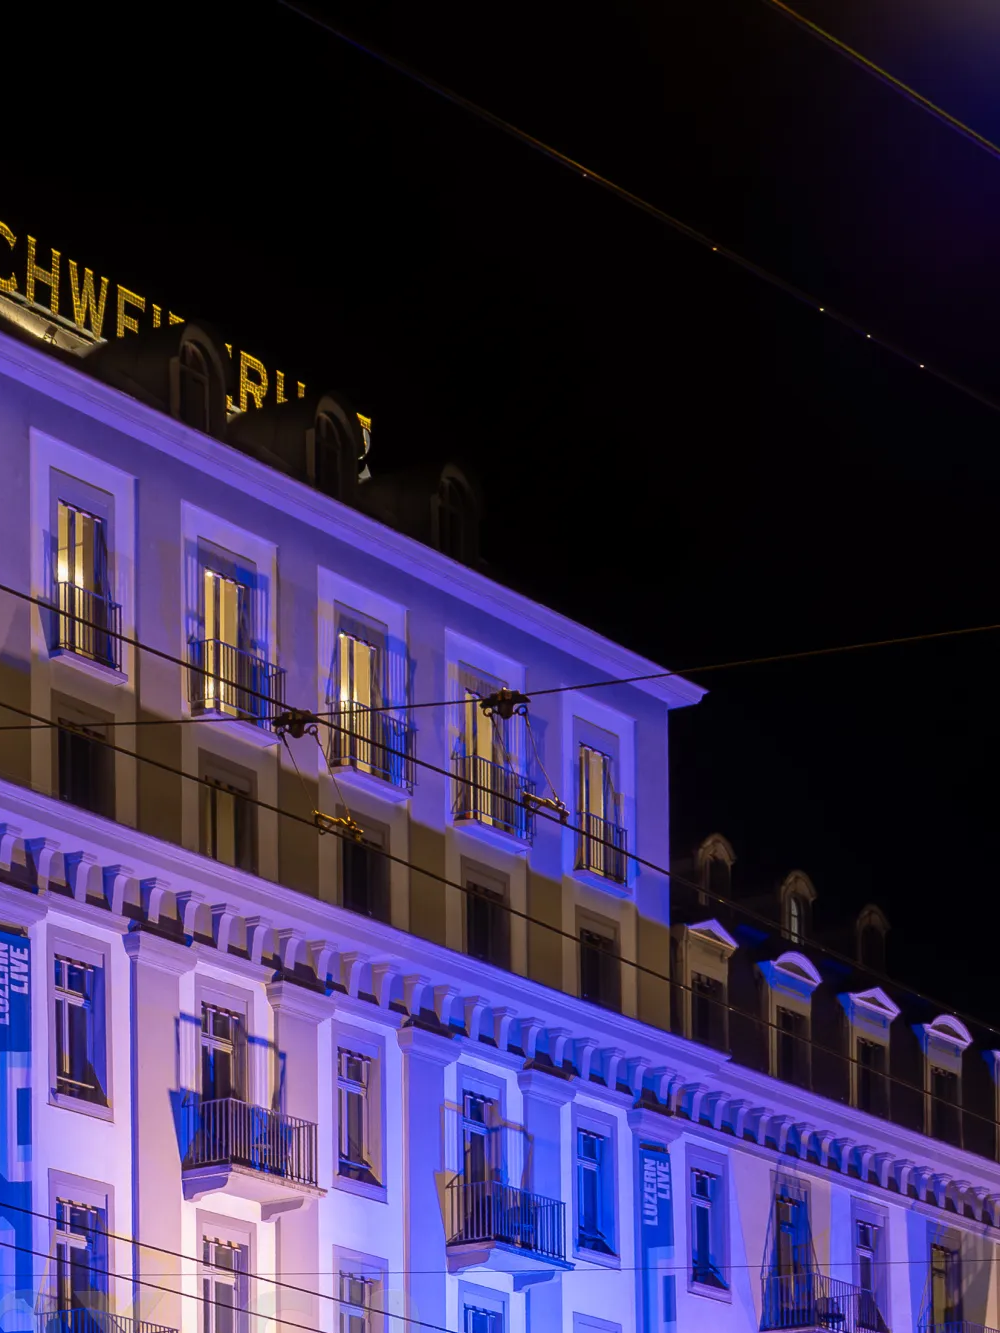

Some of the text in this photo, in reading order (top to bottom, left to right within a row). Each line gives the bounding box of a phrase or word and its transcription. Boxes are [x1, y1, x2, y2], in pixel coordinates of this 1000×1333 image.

[10, 945, 29, 995] LIVE
[643, 1157, 658, 1226] LUZERN
[657, 1160, 670, 1200] LIVE
